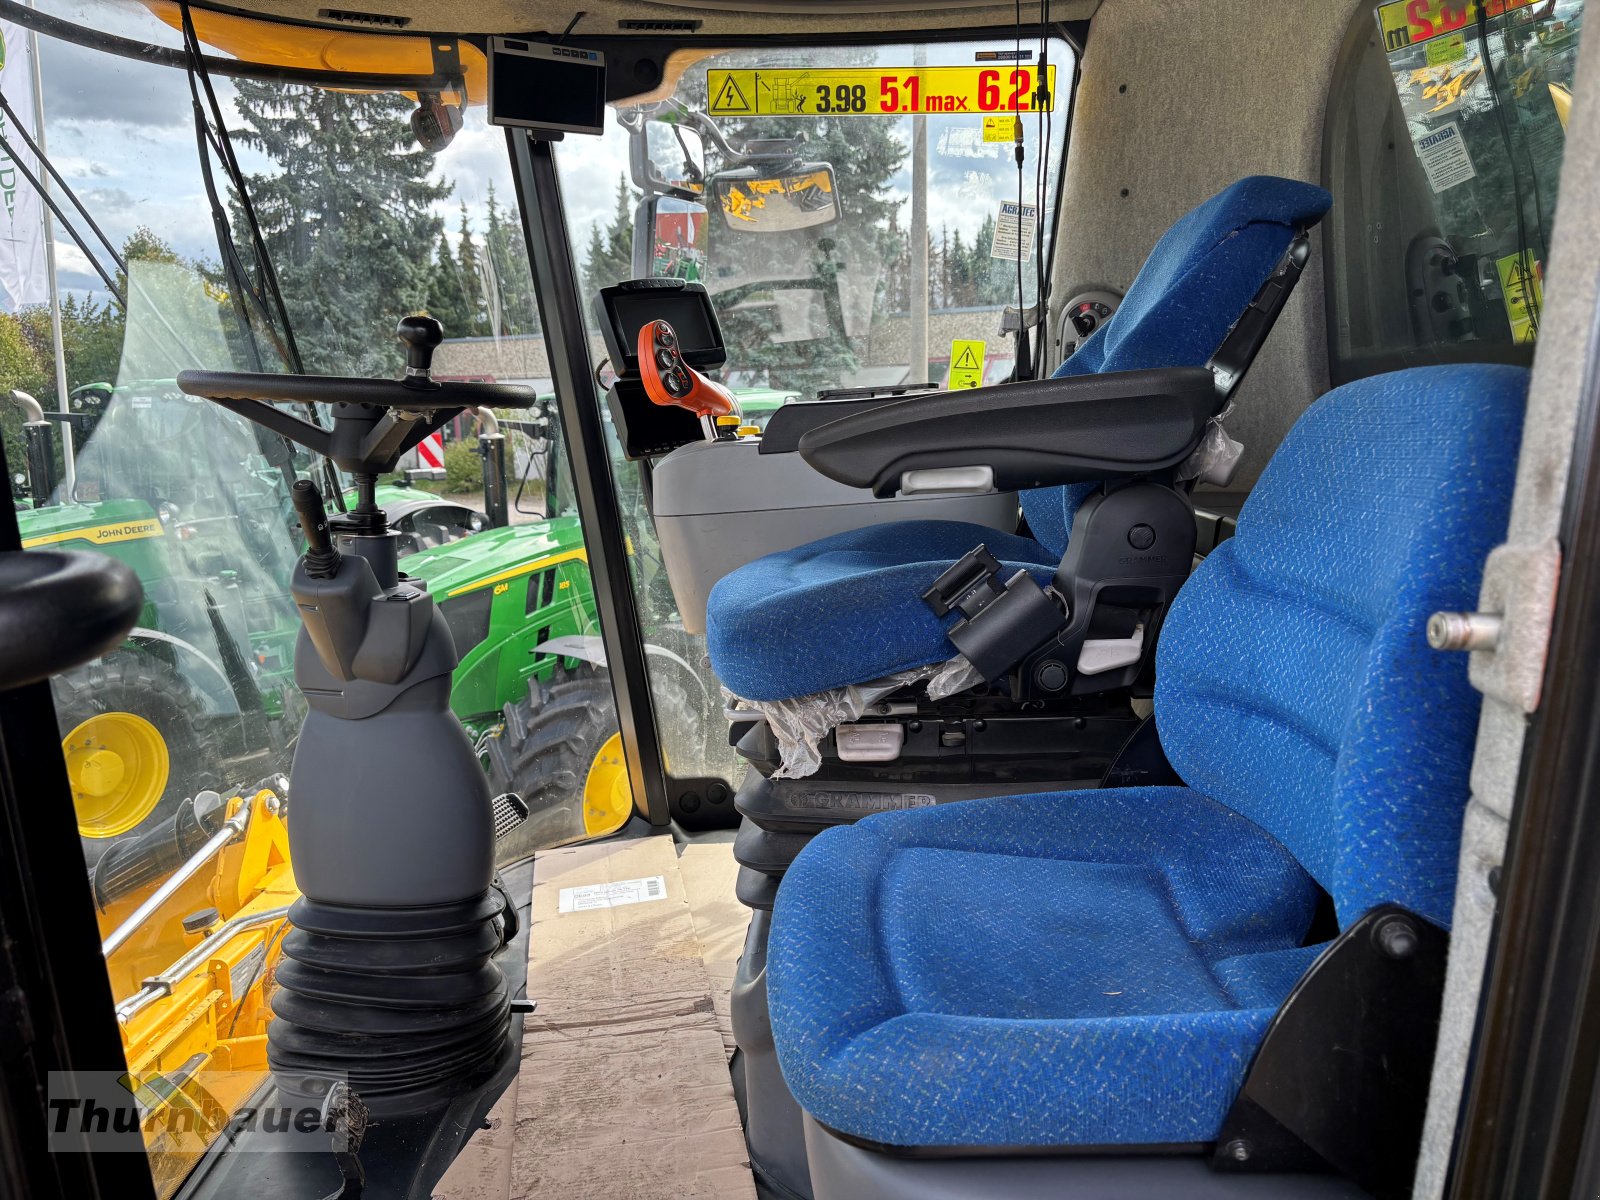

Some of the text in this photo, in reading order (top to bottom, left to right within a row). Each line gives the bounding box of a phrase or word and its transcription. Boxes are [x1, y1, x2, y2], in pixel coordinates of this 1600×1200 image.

[816, 85, 866, 113] 3.98
[880, 76, 920, 112] 5.1
[97, 524, 156, 539] JOHN DEERE
[494, 583, 508, 595] 6M
